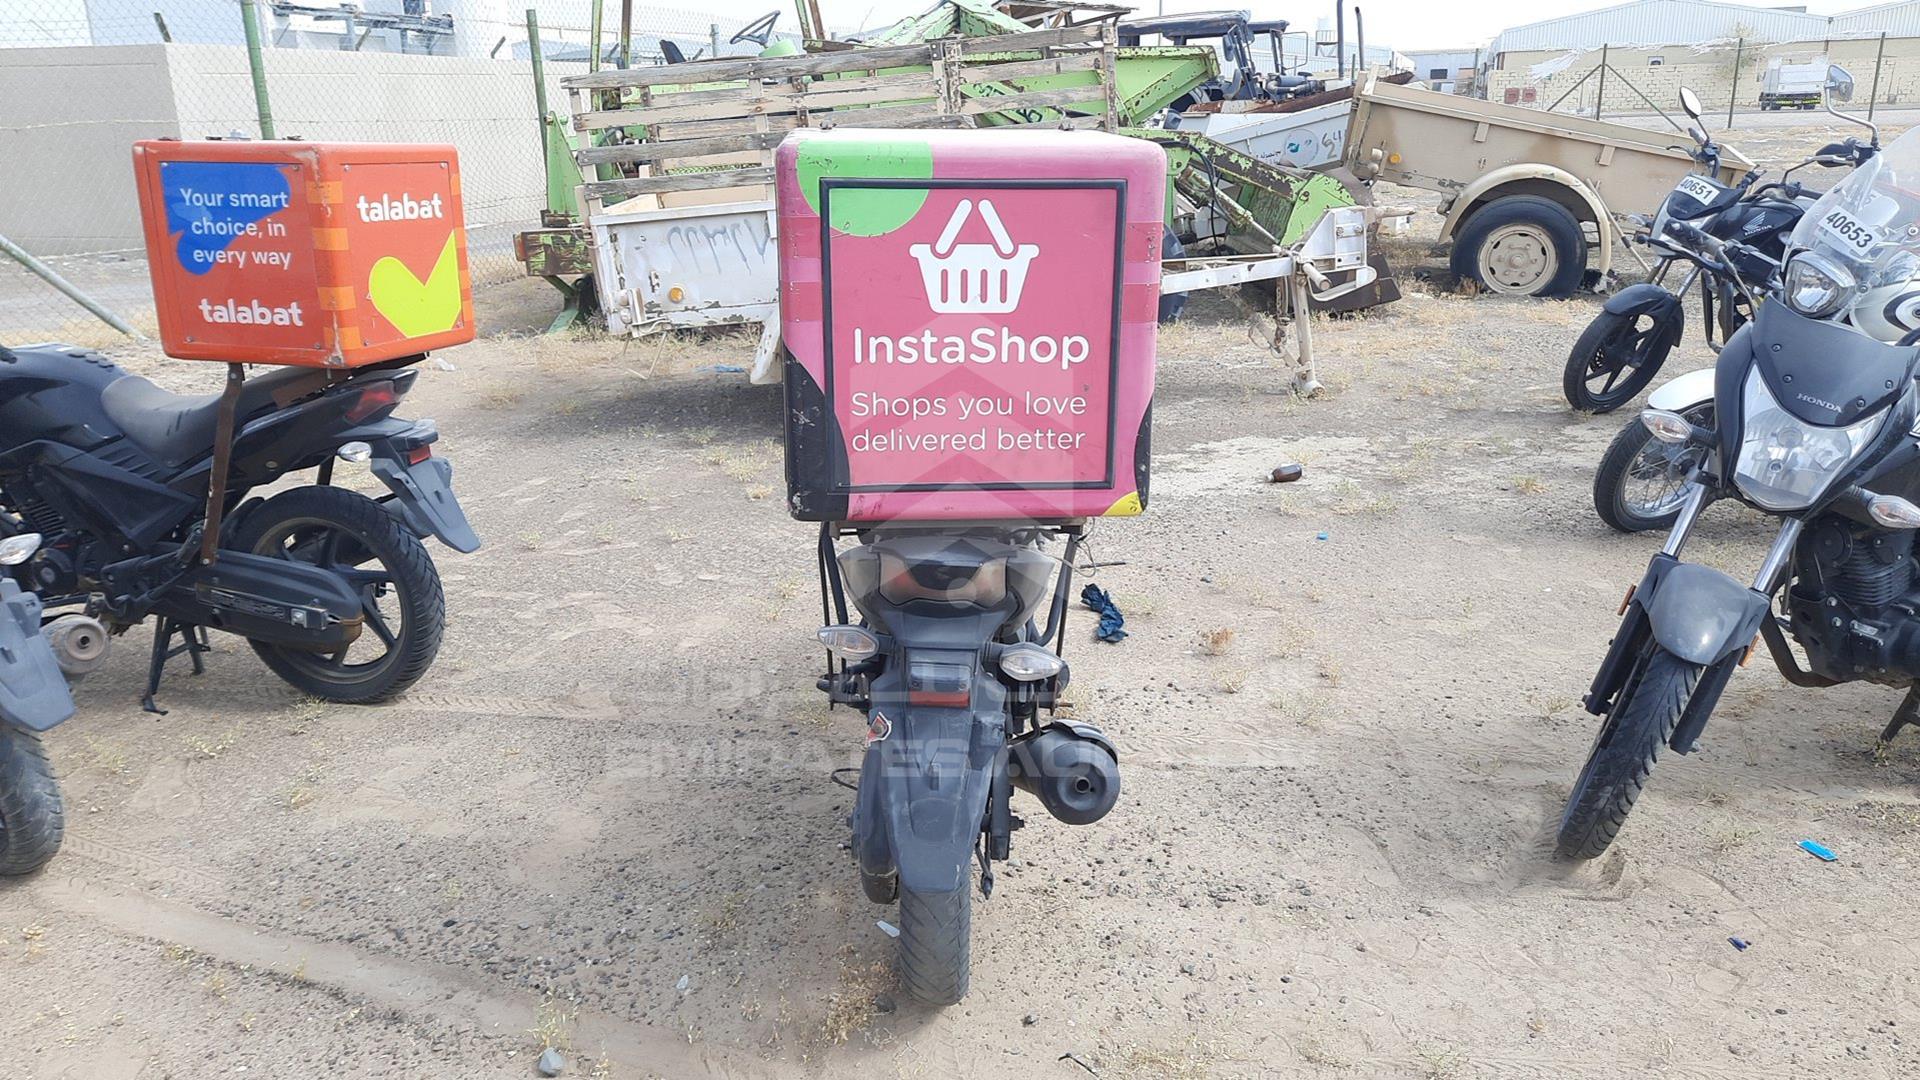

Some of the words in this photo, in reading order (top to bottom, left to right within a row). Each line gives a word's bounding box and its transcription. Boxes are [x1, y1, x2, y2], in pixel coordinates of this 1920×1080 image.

[180, 188, 223, 206] Your
[229, 191, 289, 208] smart
[356, 193, 443, 223] talabat
[191, 217, 263, 238] choice,
[267, 218, 286, 236] in
[1826, 212, 1873, 248] 40653
[193, 249, 246, 269] every
[251, 251, 291, 270] way
[198, 298, 303, 326] talabat
[854, 327, 1090, 370] InstaShop
[851, 391, 947, 420] Shops
[958, 396, 1013, 420] you
[1025, 390, 1087, 416] love
[1796, 392, 1842, 413] HONDA
[852, 428, 986, 451] delivered
[998, 428, 1086, 450] better
